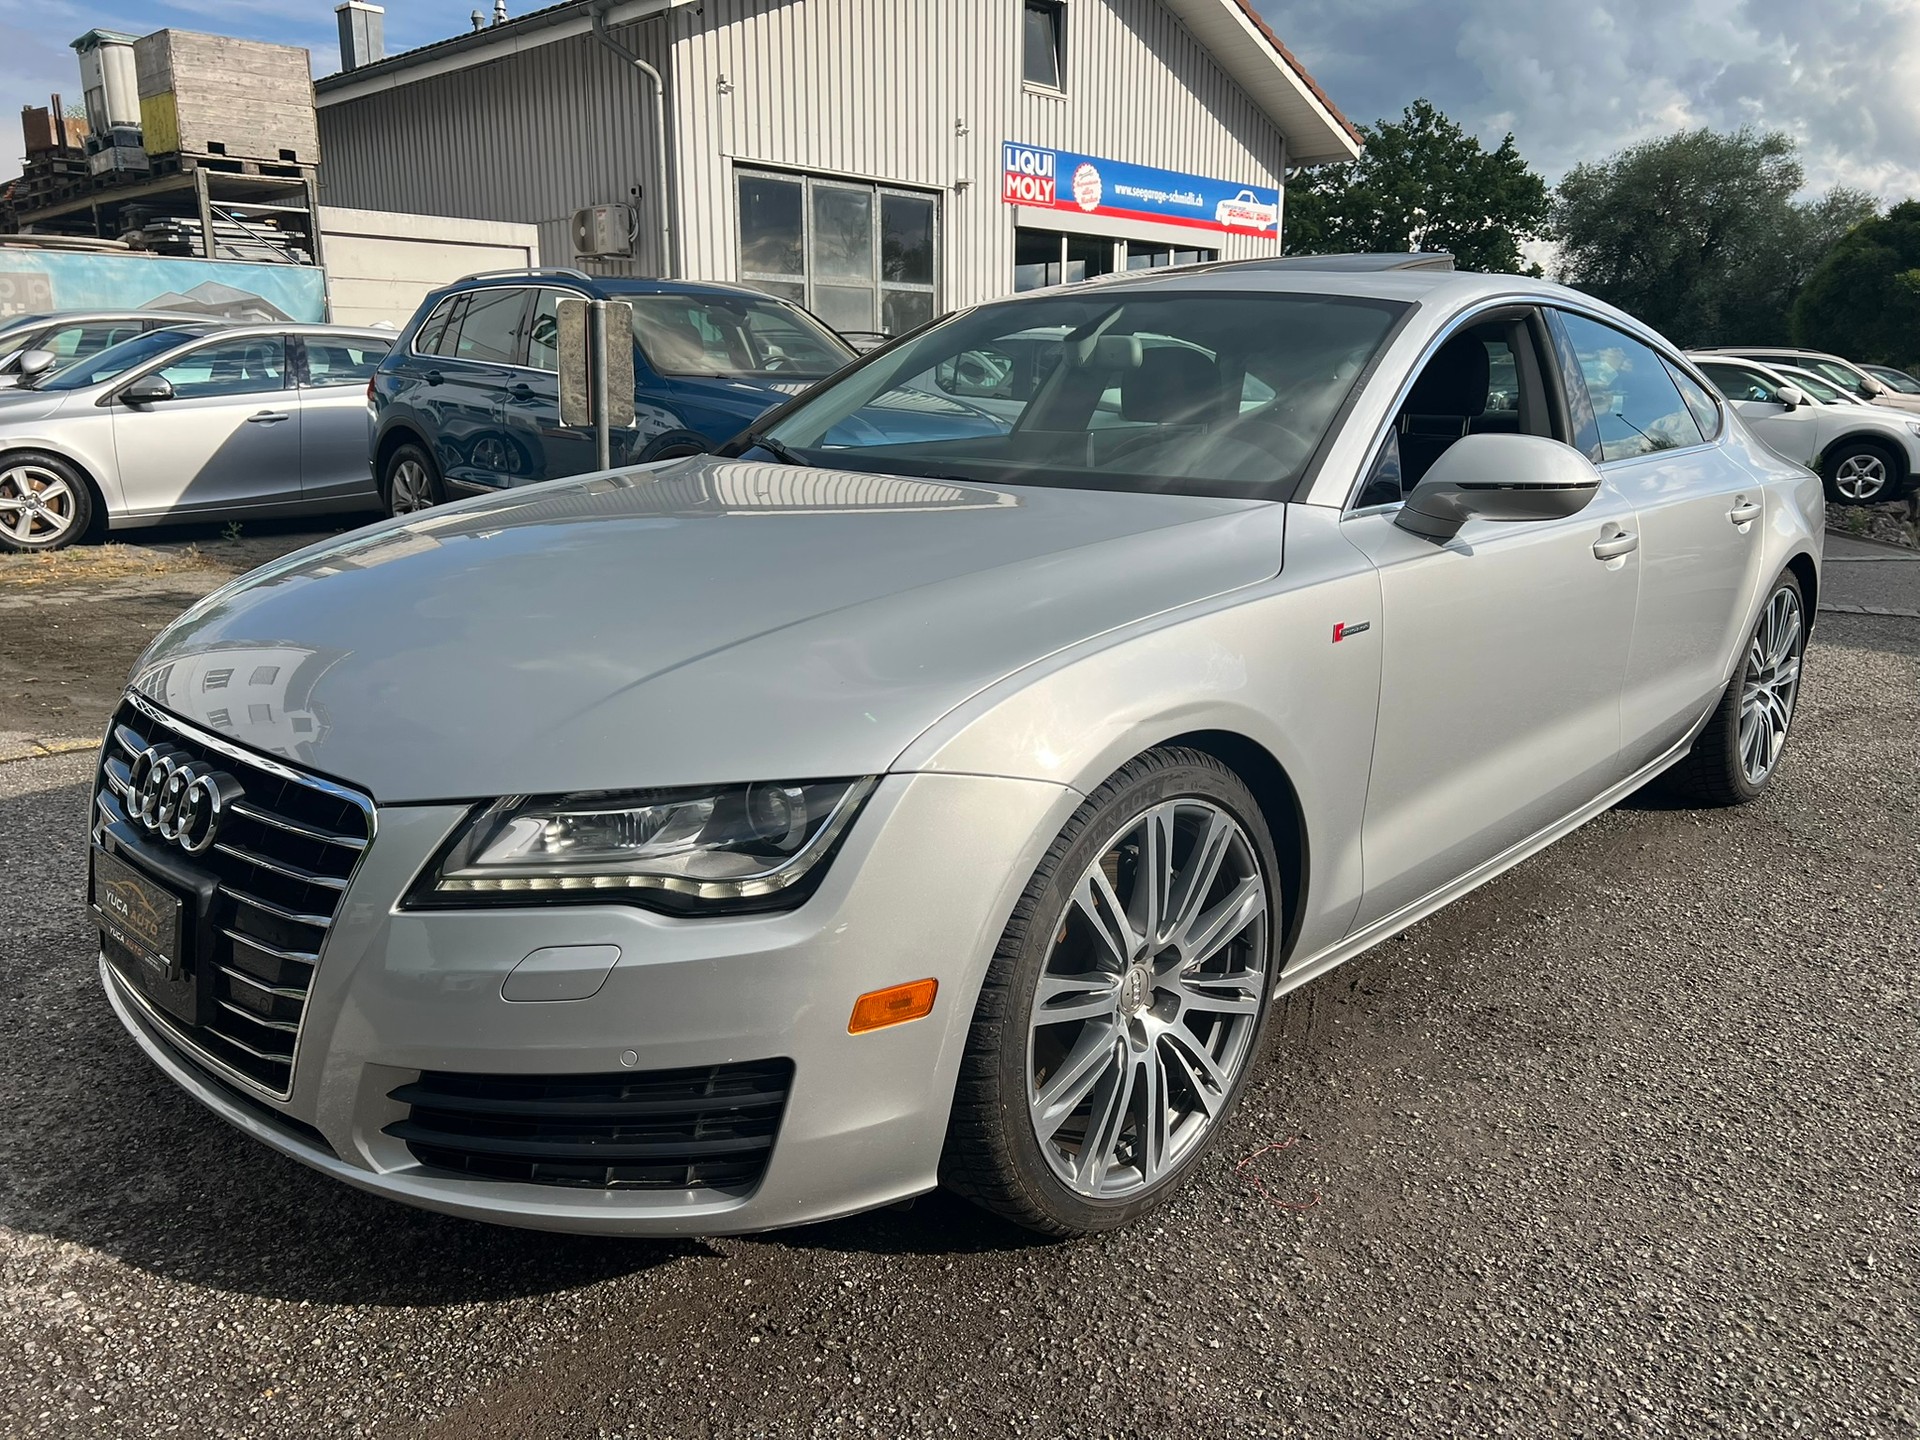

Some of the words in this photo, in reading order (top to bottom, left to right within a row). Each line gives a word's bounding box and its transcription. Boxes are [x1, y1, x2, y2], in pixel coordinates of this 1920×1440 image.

[1006, 147, 1053, 177] LIQUI
[1006, 174, 1054, 202] MOLY
[1114, 184, 1204, 207] www.seegarage-schmidli.ch
[106, 889, 128, 916] YUCA
[130, 910, 158, 936] AUTO
[109, 925, 125, 943] YUCA
[125, 939, 143, 957] AUTO
